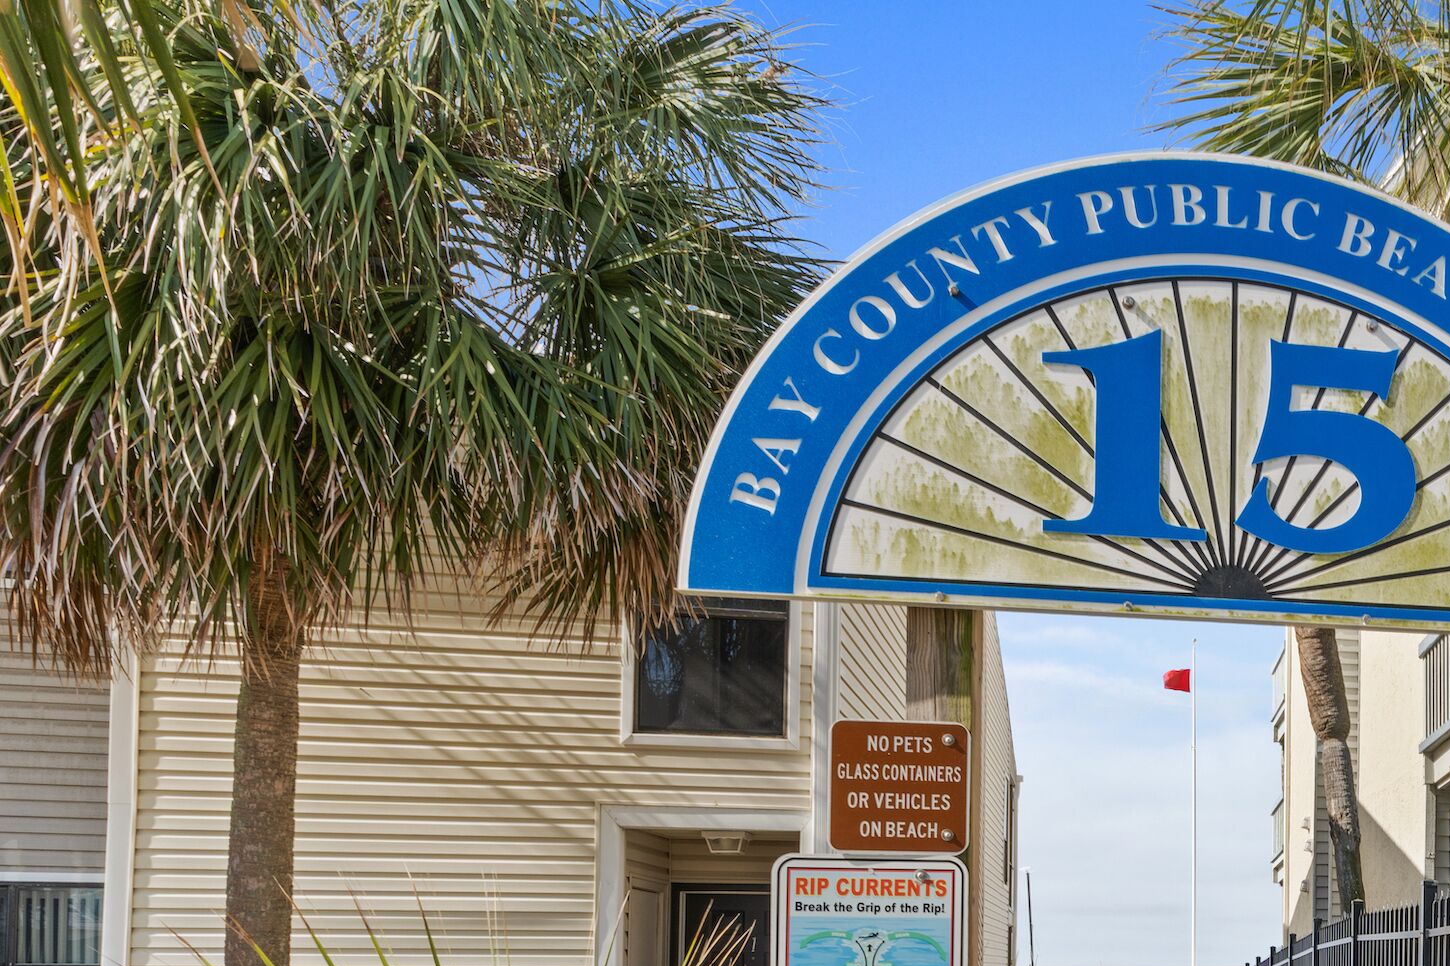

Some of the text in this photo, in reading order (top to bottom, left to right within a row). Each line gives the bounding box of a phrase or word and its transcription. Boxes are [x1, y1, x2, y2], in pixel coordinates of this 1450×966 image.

[730, 377, 822, 517] BAY
[813, 201, 1058, 376] COUNTY
[1076, 183, 1321, 241] PUBLIC
[1042, 329, 1417, 555] 15
[867, 735, 933, 753] NO PETS
[837, 763, 962, 783] GLASS CONTAINERS
[847, 792, 951, 811] OR VEHICLES
[860, 821, 938, 838] ON BEACH
[795, 877, 948, 897] RIP CURRENTS
[795, 902, 945, 916] Break the Grip of the Rip!
